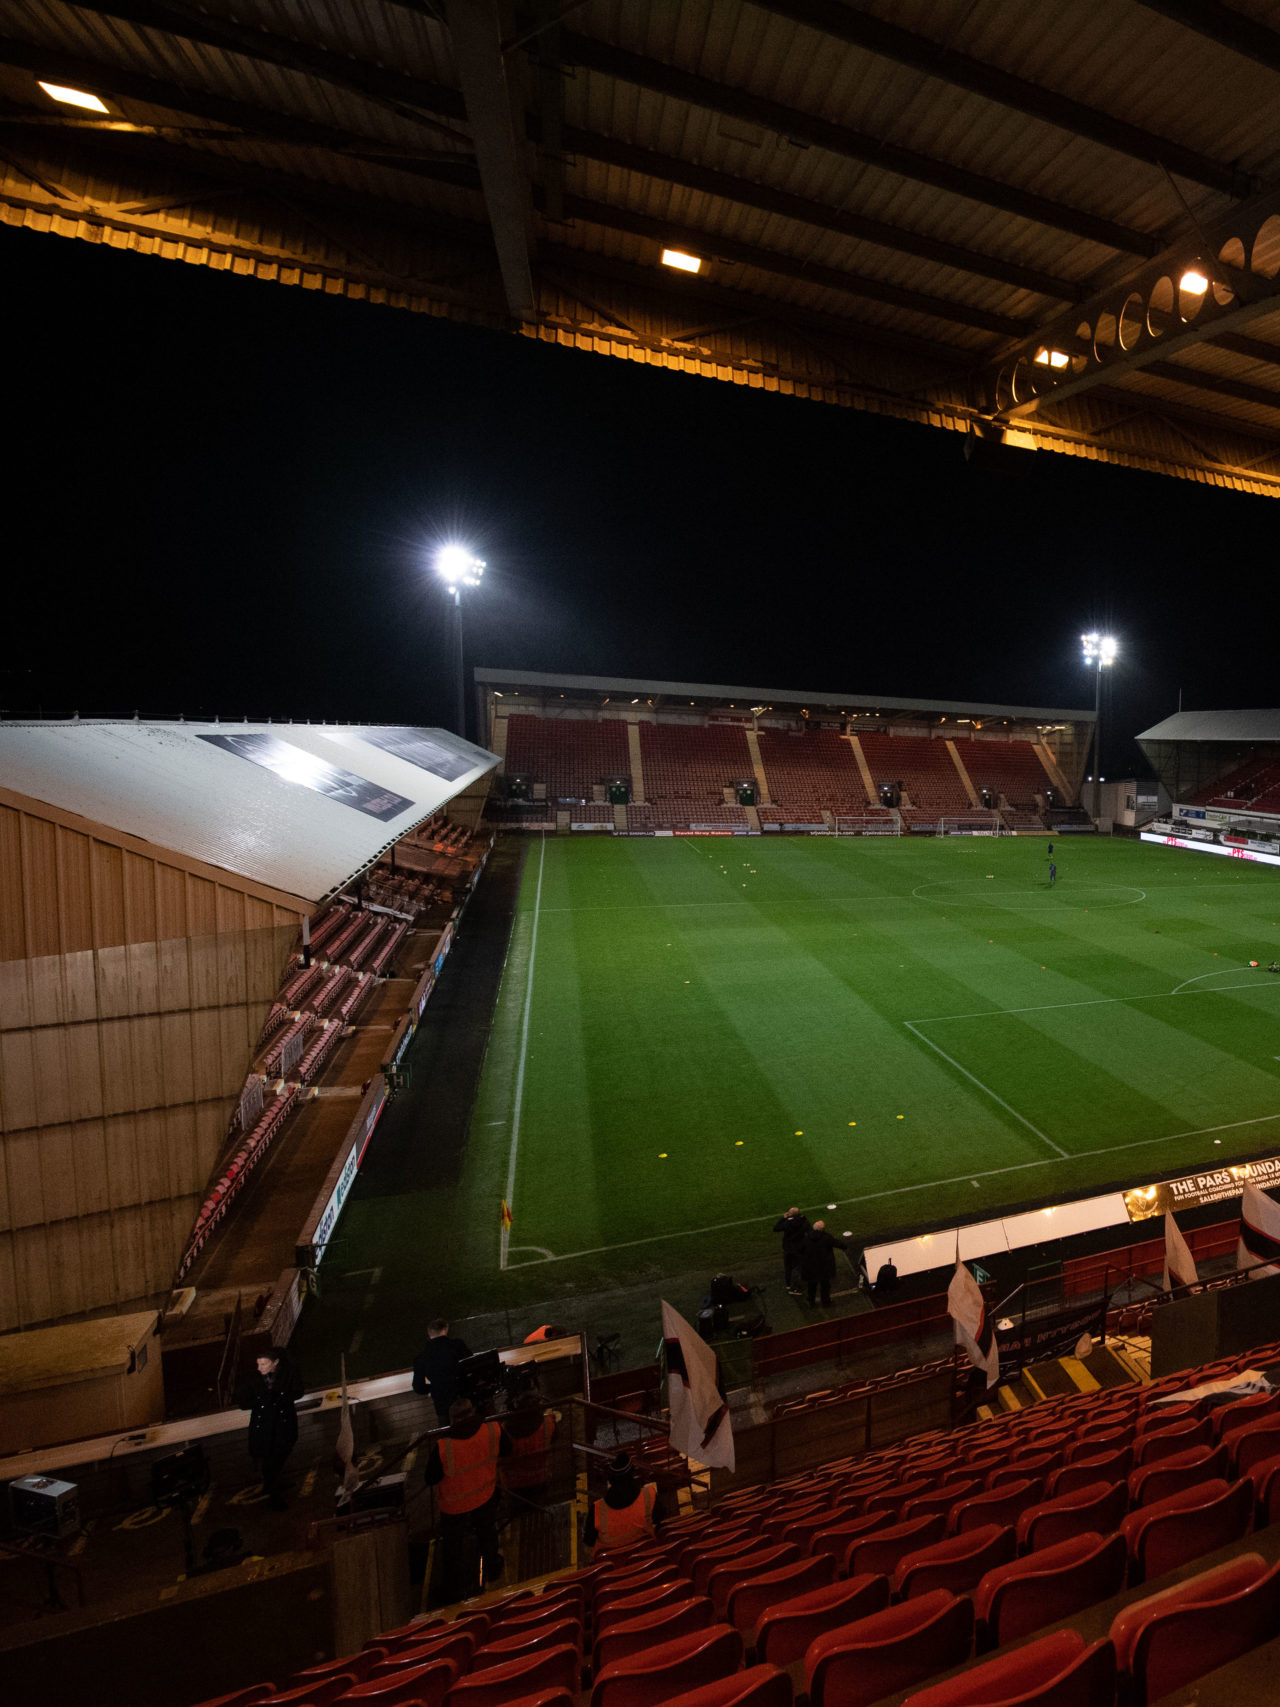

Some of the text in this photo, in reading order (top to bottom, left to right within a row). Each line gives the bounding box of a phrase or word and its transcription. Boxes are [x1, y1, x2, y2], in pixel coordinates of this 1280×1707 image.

[1169, 1178, 1195, 1195] THE
[1196, 1171, 1231, 1190] PARS
[1208, 1182, 1234, 1194] COACHING
